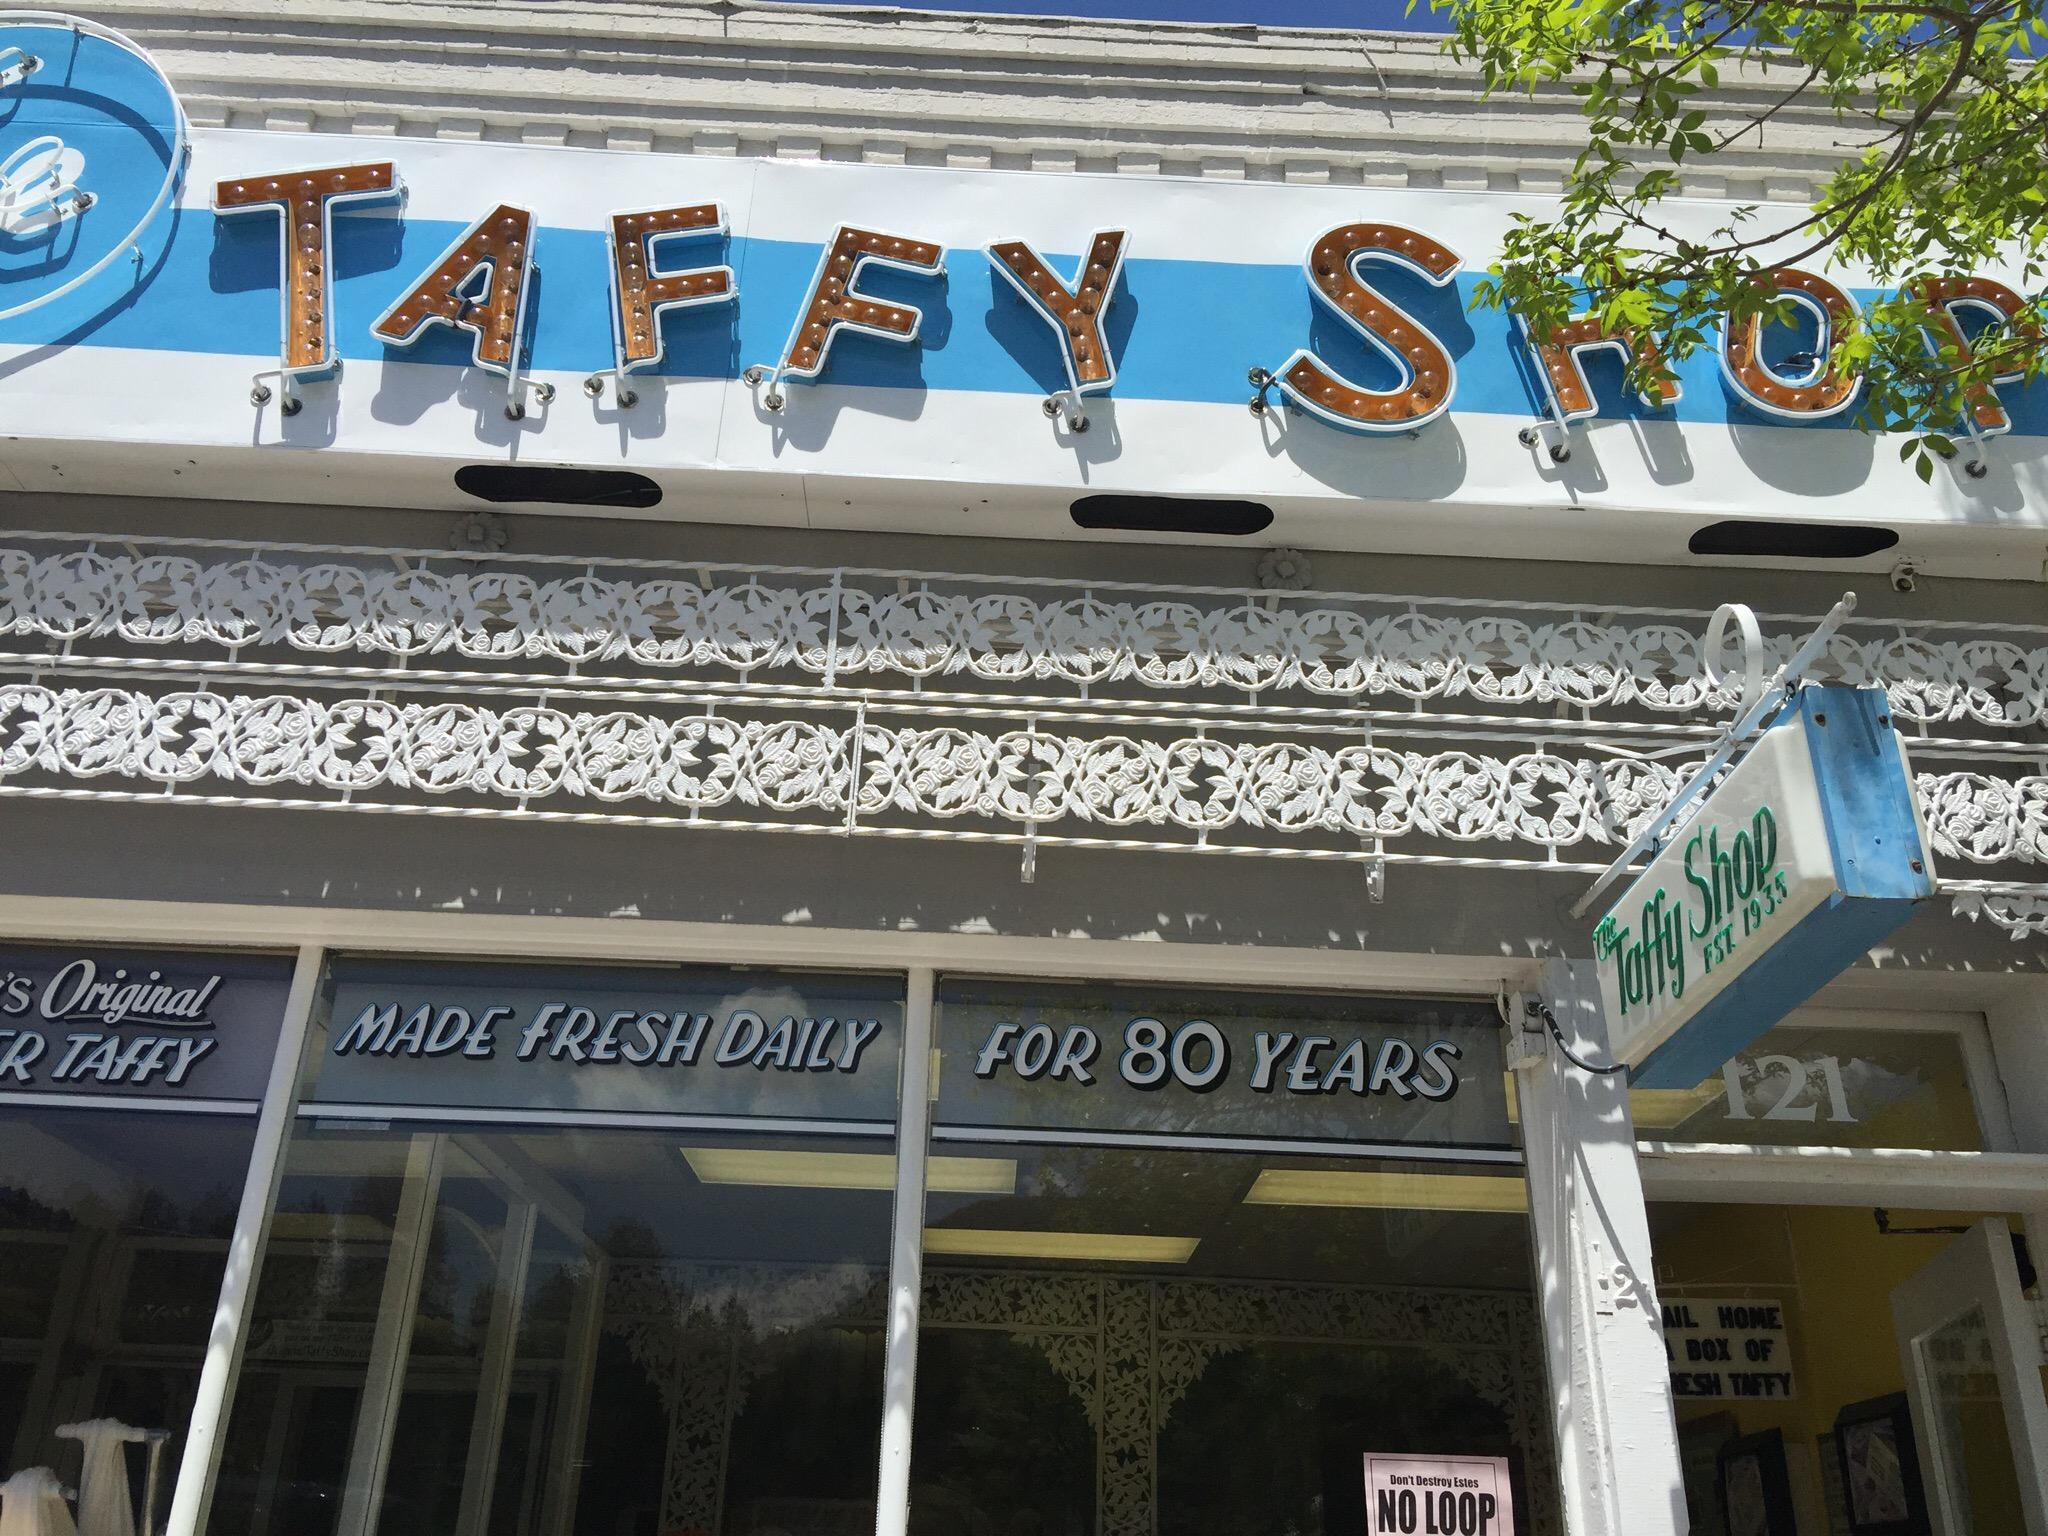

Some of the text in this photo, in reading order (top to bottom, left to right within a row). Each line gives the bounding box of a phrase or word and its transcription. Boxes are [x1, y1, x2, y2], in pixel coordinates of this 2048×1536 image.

[210, 157, 1131, 395] TAFFY
[1609, 806, 1777, 1015] Taffy Shop
[1592, 914, 1617, 961] The
[39, 959, 222, 1024] Original
[51, 1033, 216, 1083] TAFFY
[333, 1001, 1461, 1099] MADE FRESH DAILY FOR 80 YEARS
[1721, 1053, 1859, 1123] 121
[1717, 1306, 1783, 1330] HOME
[1686, 1338, 1731, 1362] BOX
[1745, 1338, 1773, 1362] OF
[1728, 1372, 1791, 1396] TAFFY
[1390, 1474, 1479, 1488] Don't Destroy Estes
[1378, 1489, 1496, 1536] NO LOOP
